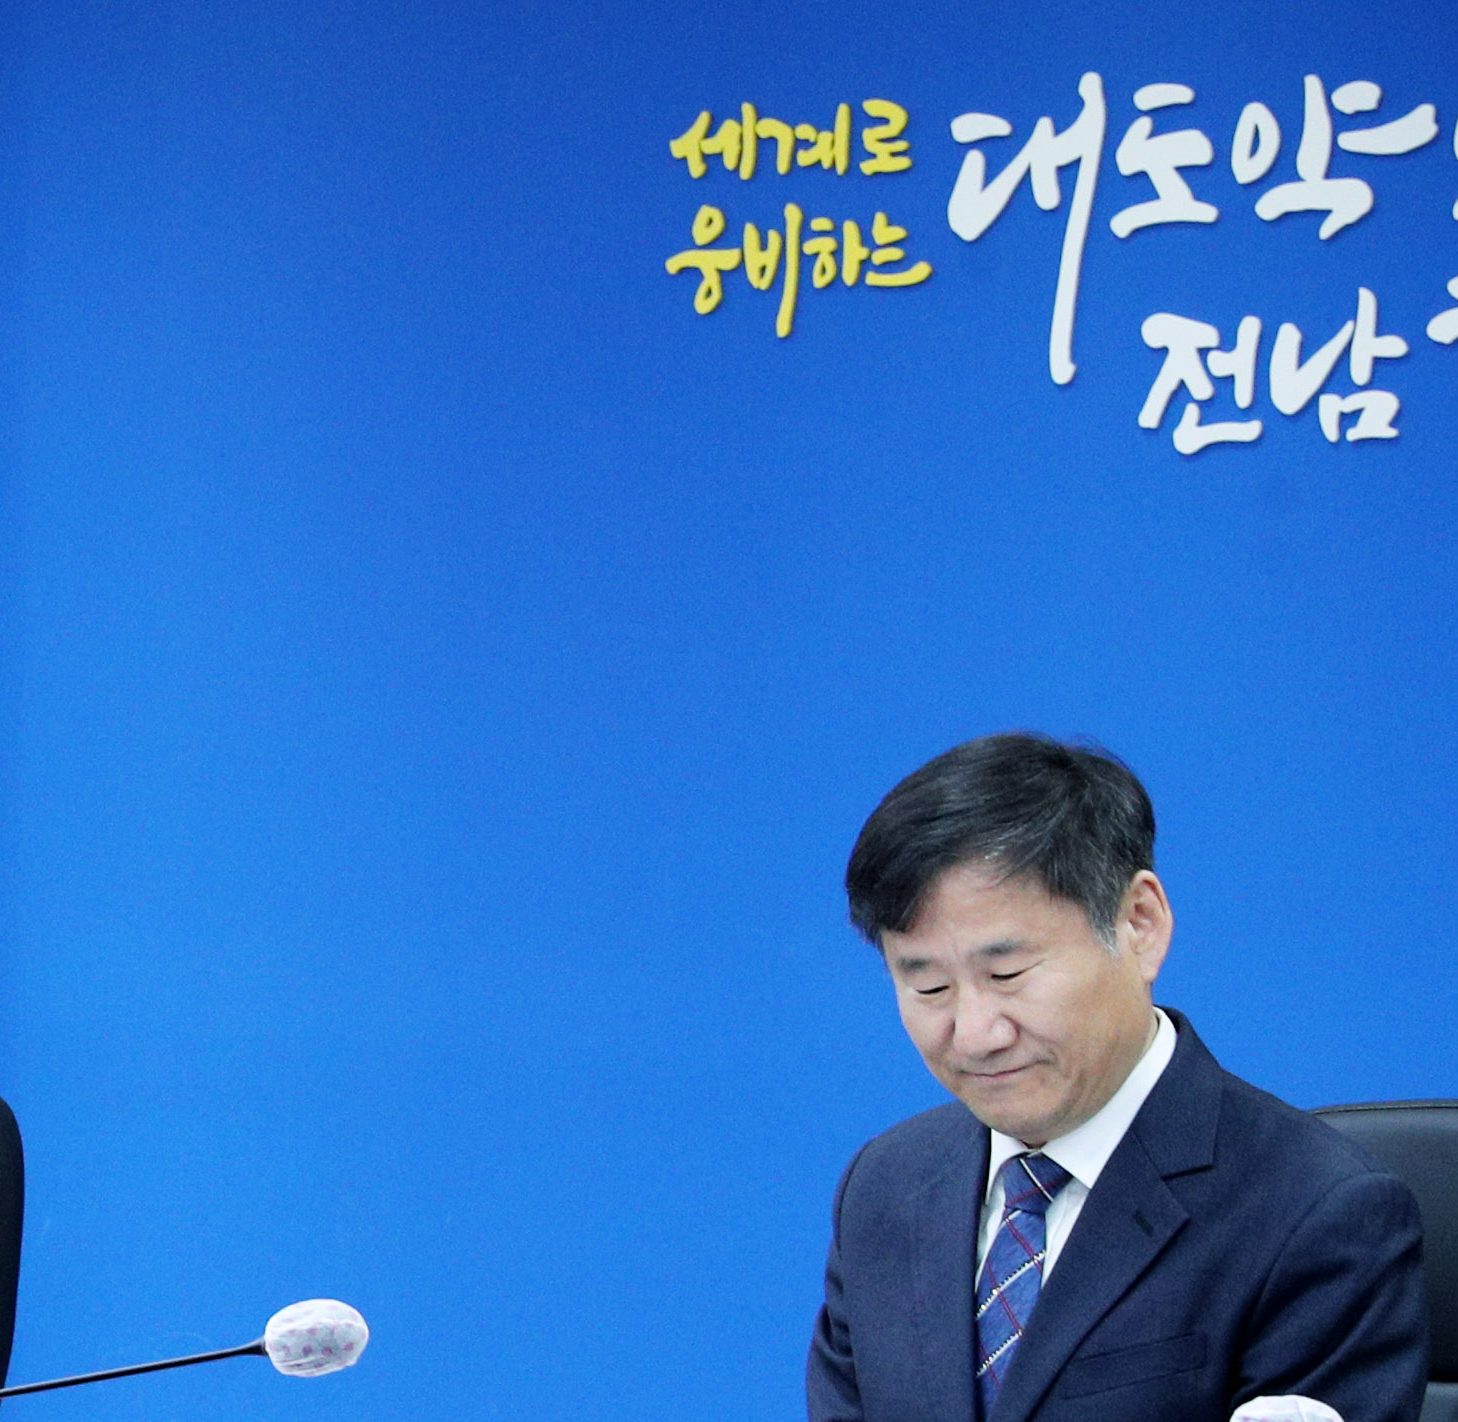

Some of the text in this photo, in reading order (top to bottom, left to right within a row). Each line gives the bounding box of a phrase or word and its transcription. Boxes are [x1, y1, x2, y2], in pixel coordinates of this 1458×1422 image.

[670, 99, 912, 181] 세계로
[665, 203, 932, 338] 웅비하는
[946, 71, 1458, 385] 대도약
[1137, 286, 1409, 454] 전남
